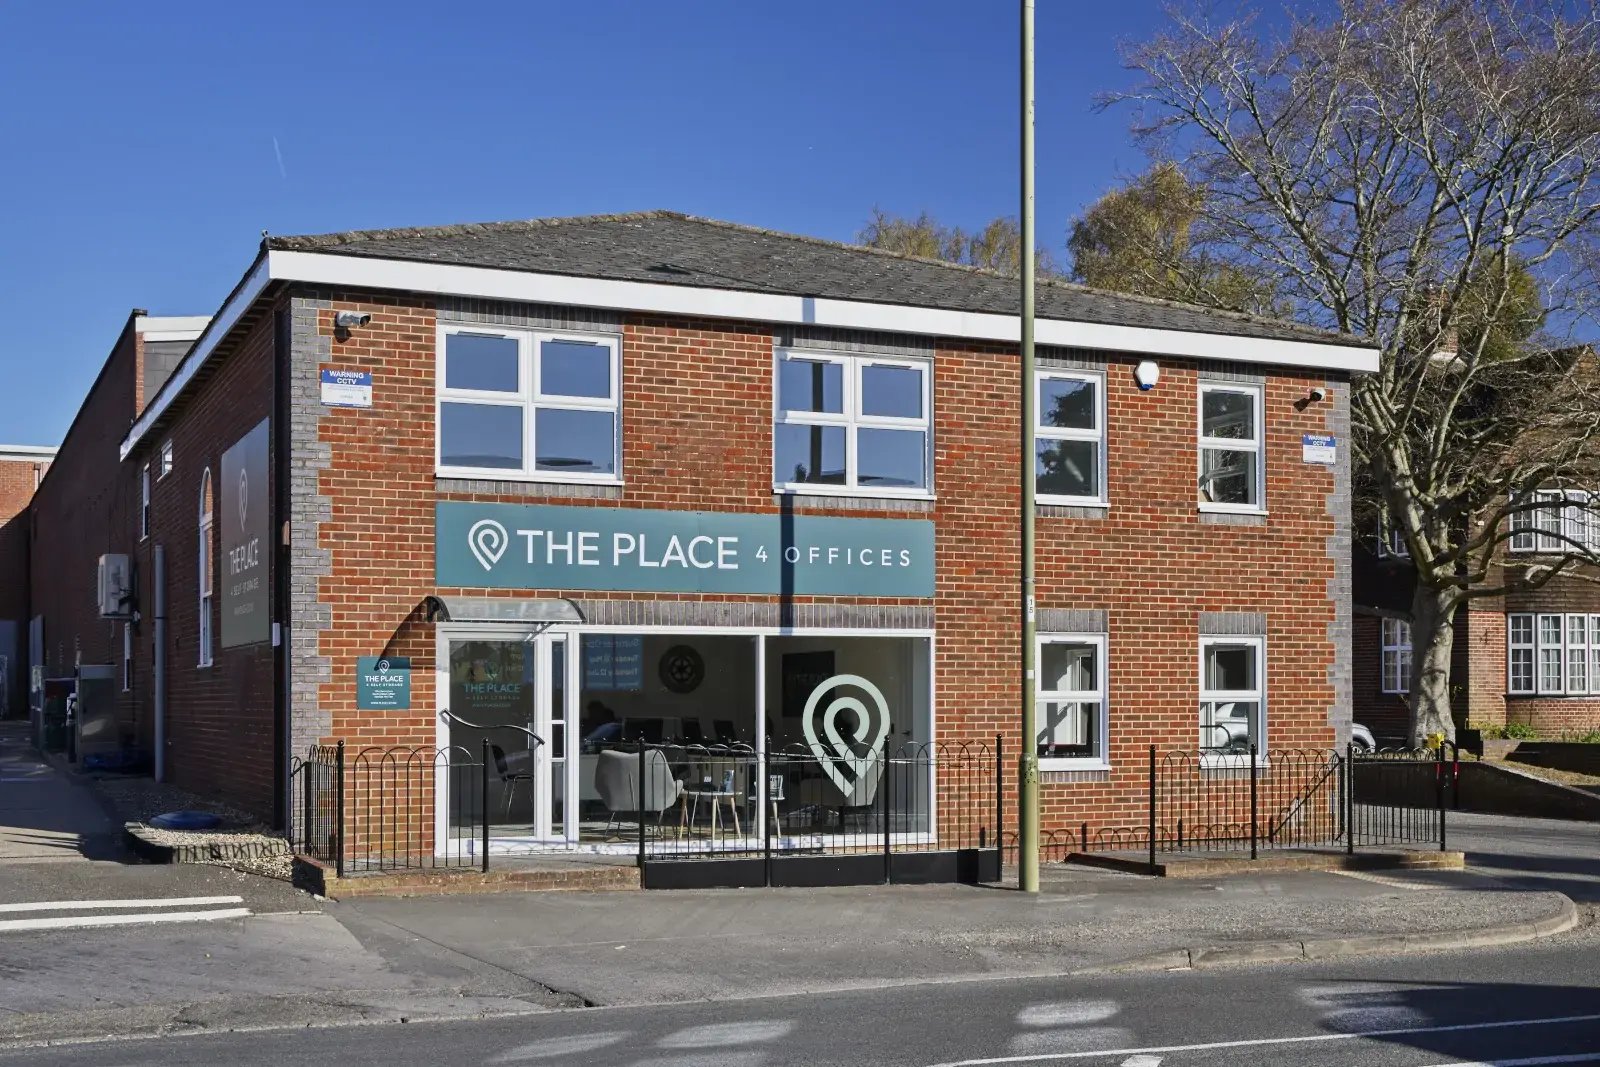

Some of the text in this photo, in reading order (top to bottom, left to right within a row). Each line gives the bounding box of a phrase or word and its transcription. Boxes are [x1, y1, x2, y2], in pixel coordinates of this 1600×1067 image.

[329, 370, 364, 378] WARNING
[229, 537, 259, 576] THE PLACE
[516, 529, 911, 570] THE PLACE 4 OFFICES
[464, 683, 521, 693] THE PLACE
